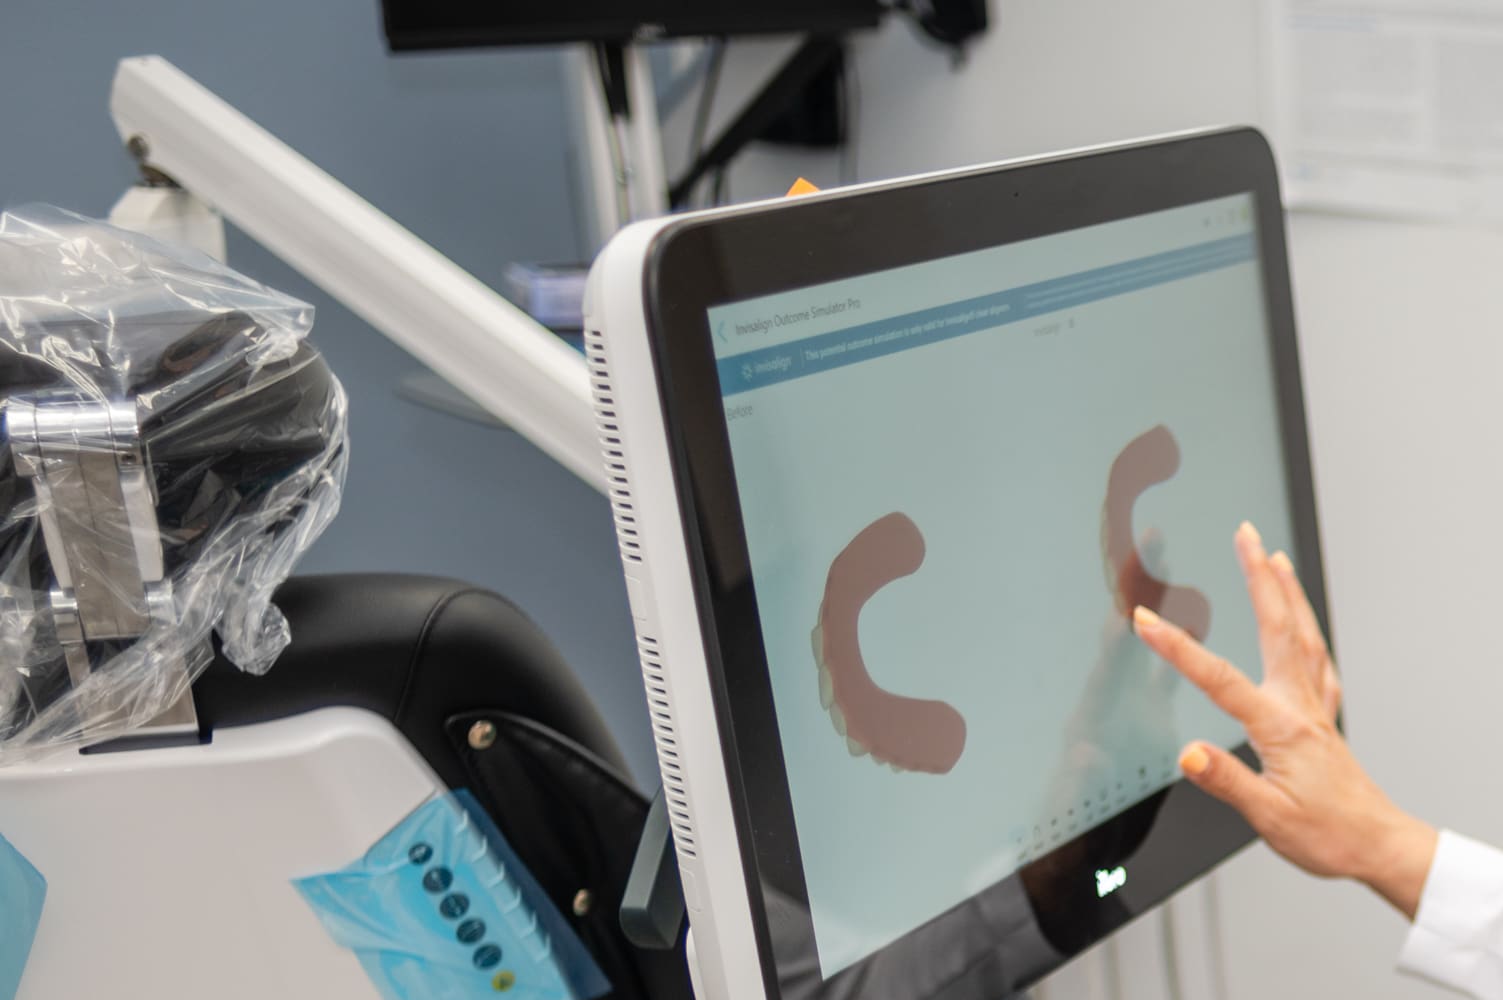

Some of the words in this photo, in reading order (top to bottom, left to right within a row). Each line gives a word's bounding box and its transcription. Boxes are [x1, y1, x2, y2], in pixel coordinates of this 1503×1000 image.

[735, 317, 773, 334] Invisalign
[774, 310, 810, 327] Outcome
[810, 303, 846, 319] Simulator
[848, 298, 861, 310] Pro
